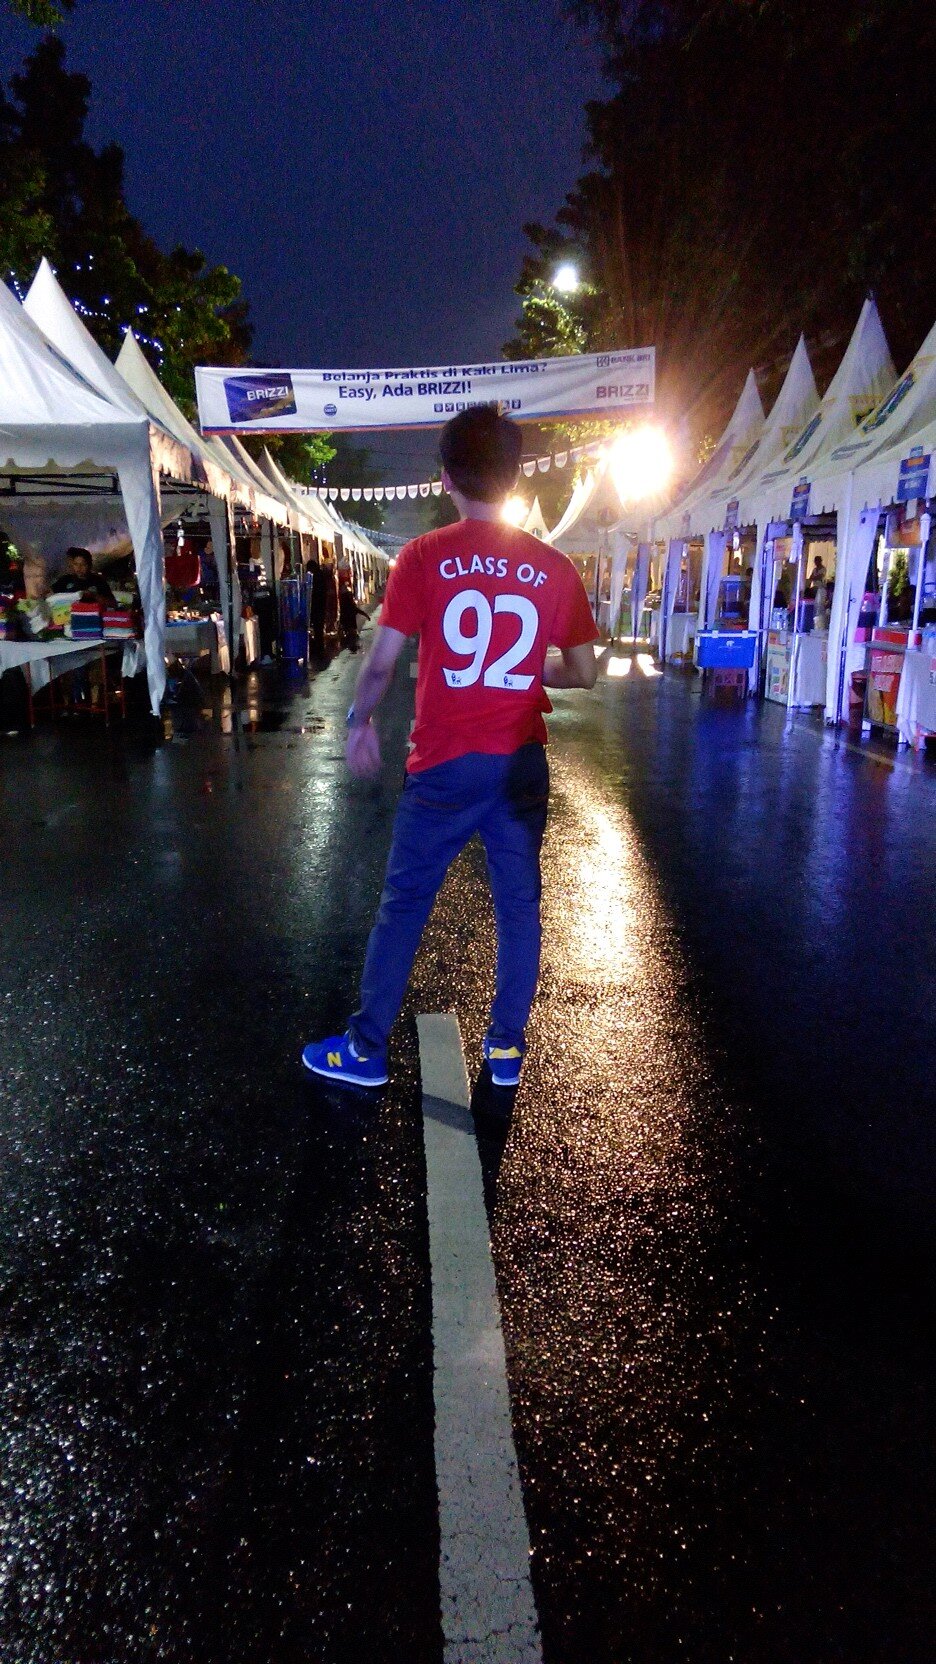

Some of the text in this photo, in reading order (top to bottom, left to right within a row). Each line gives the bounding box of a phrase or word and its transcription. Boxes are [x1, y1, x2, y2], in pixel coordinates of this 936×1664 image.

[322, 361, 548, 384] Belanja Praktis di Kaki Lima?
[246, 385, 289, 402] BRIZZI
[339, 380, 472, 402] Easy, Ada BRIZZI!
[596, 383, 650, 399] BRIZZI
[438, 554, 548, 588] CLASS OF
[442, 588, 539, 691] 92
[326, 1051, 343, 1068] N
